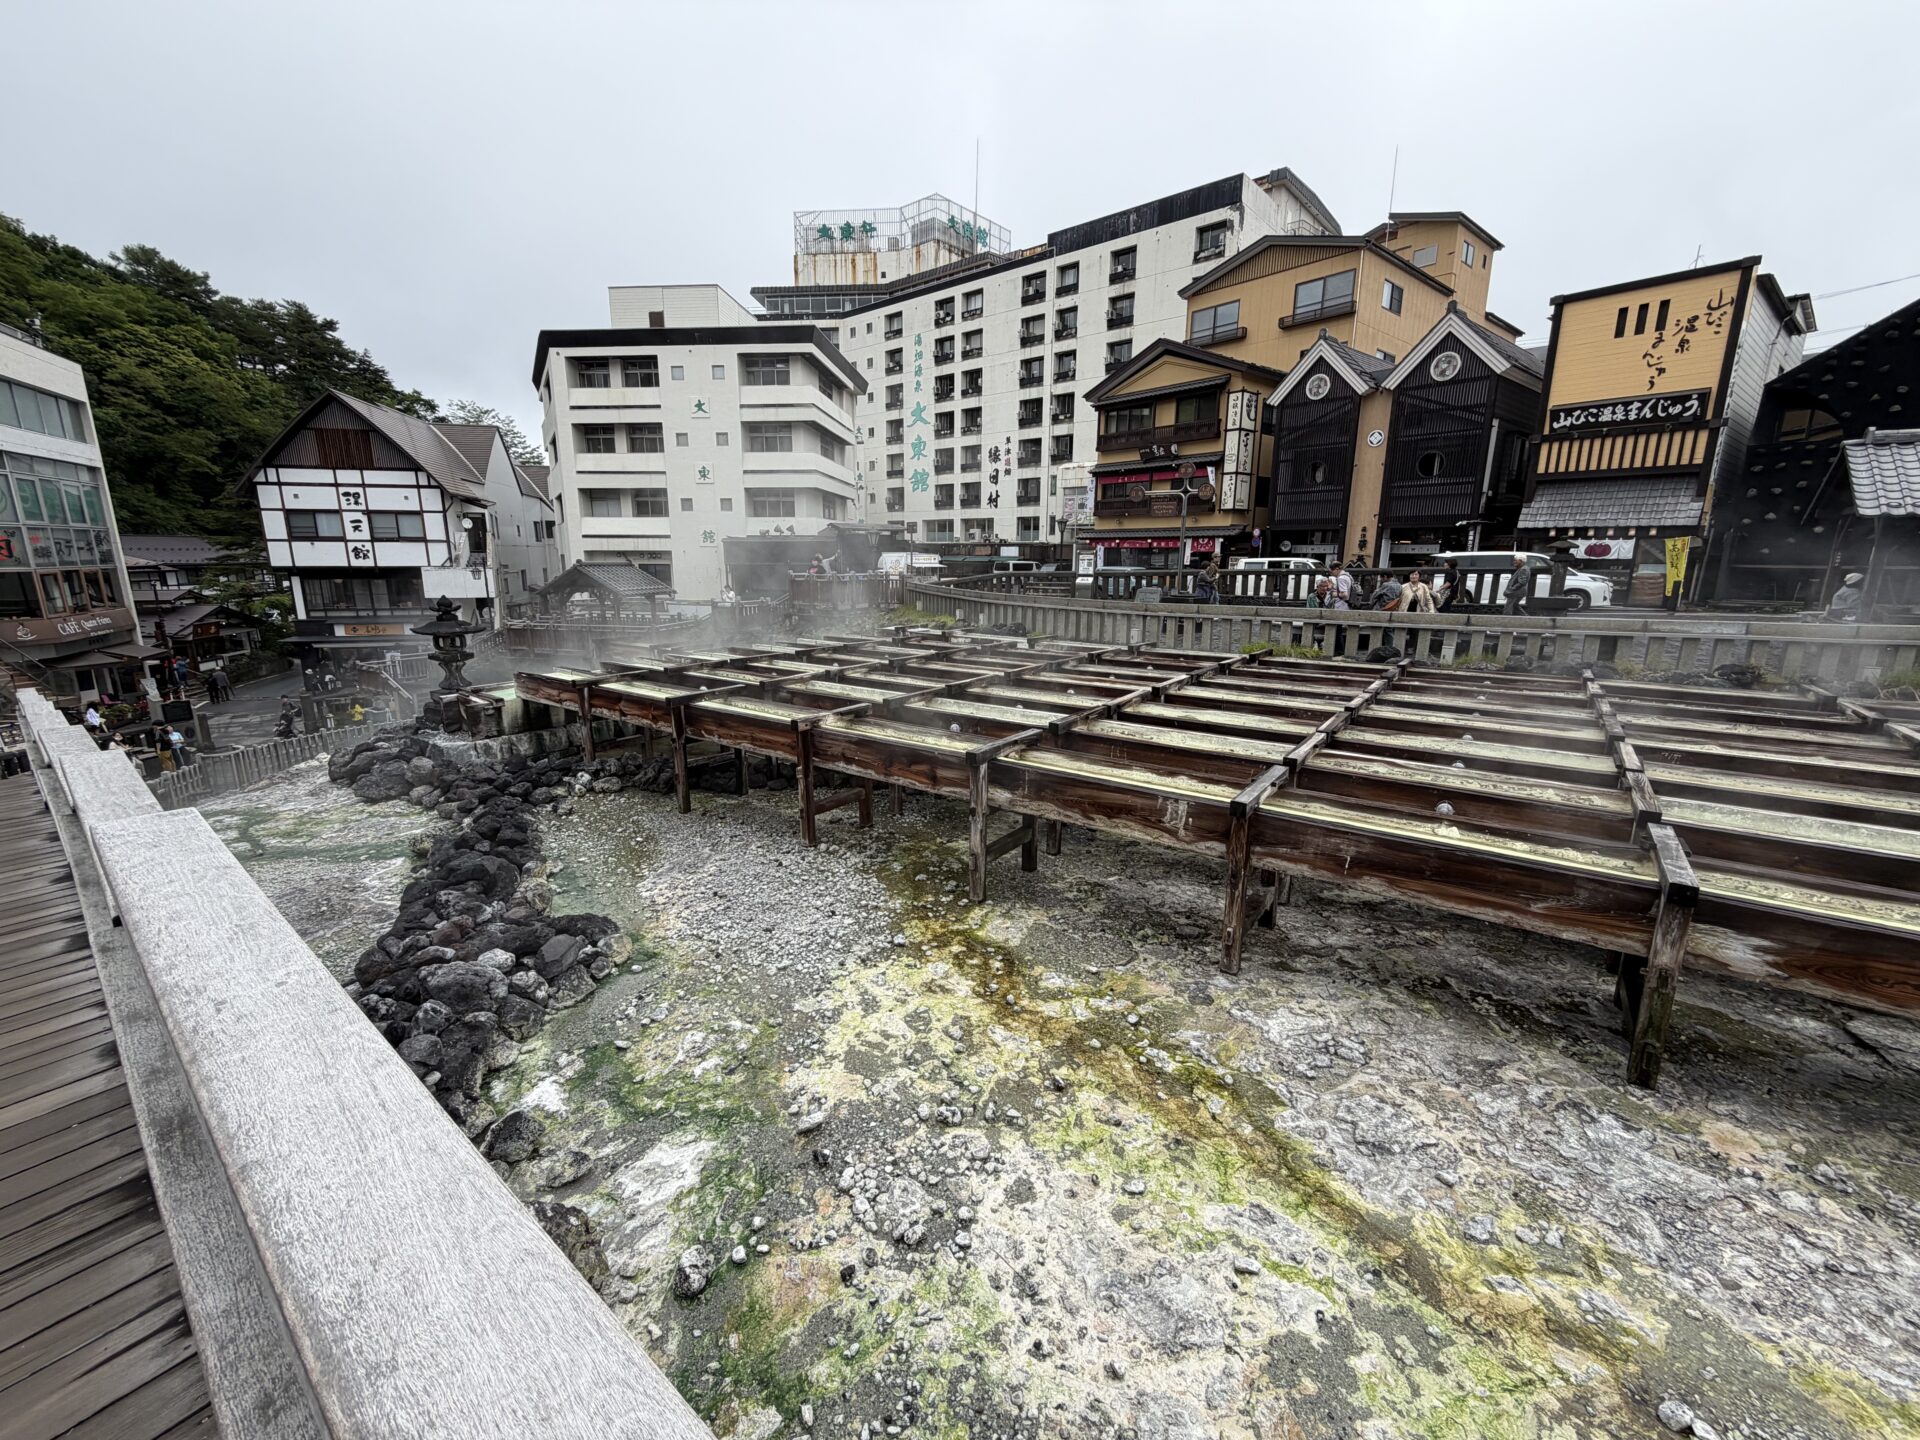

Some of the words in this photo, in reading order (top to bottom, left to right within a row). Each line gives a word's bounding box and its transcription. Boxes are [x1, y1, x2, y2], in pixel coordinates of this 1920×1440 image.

[1671, 314, 1700, 354] 温泉
[1703, 287, 1735, 335] 山びこ
[1641, 331, 1668, 392] まんじゅう
[1552, 393, 1699, 429] 山びこ温泉まんじゅう
[986, 445, 1001, 509] 縁日村
